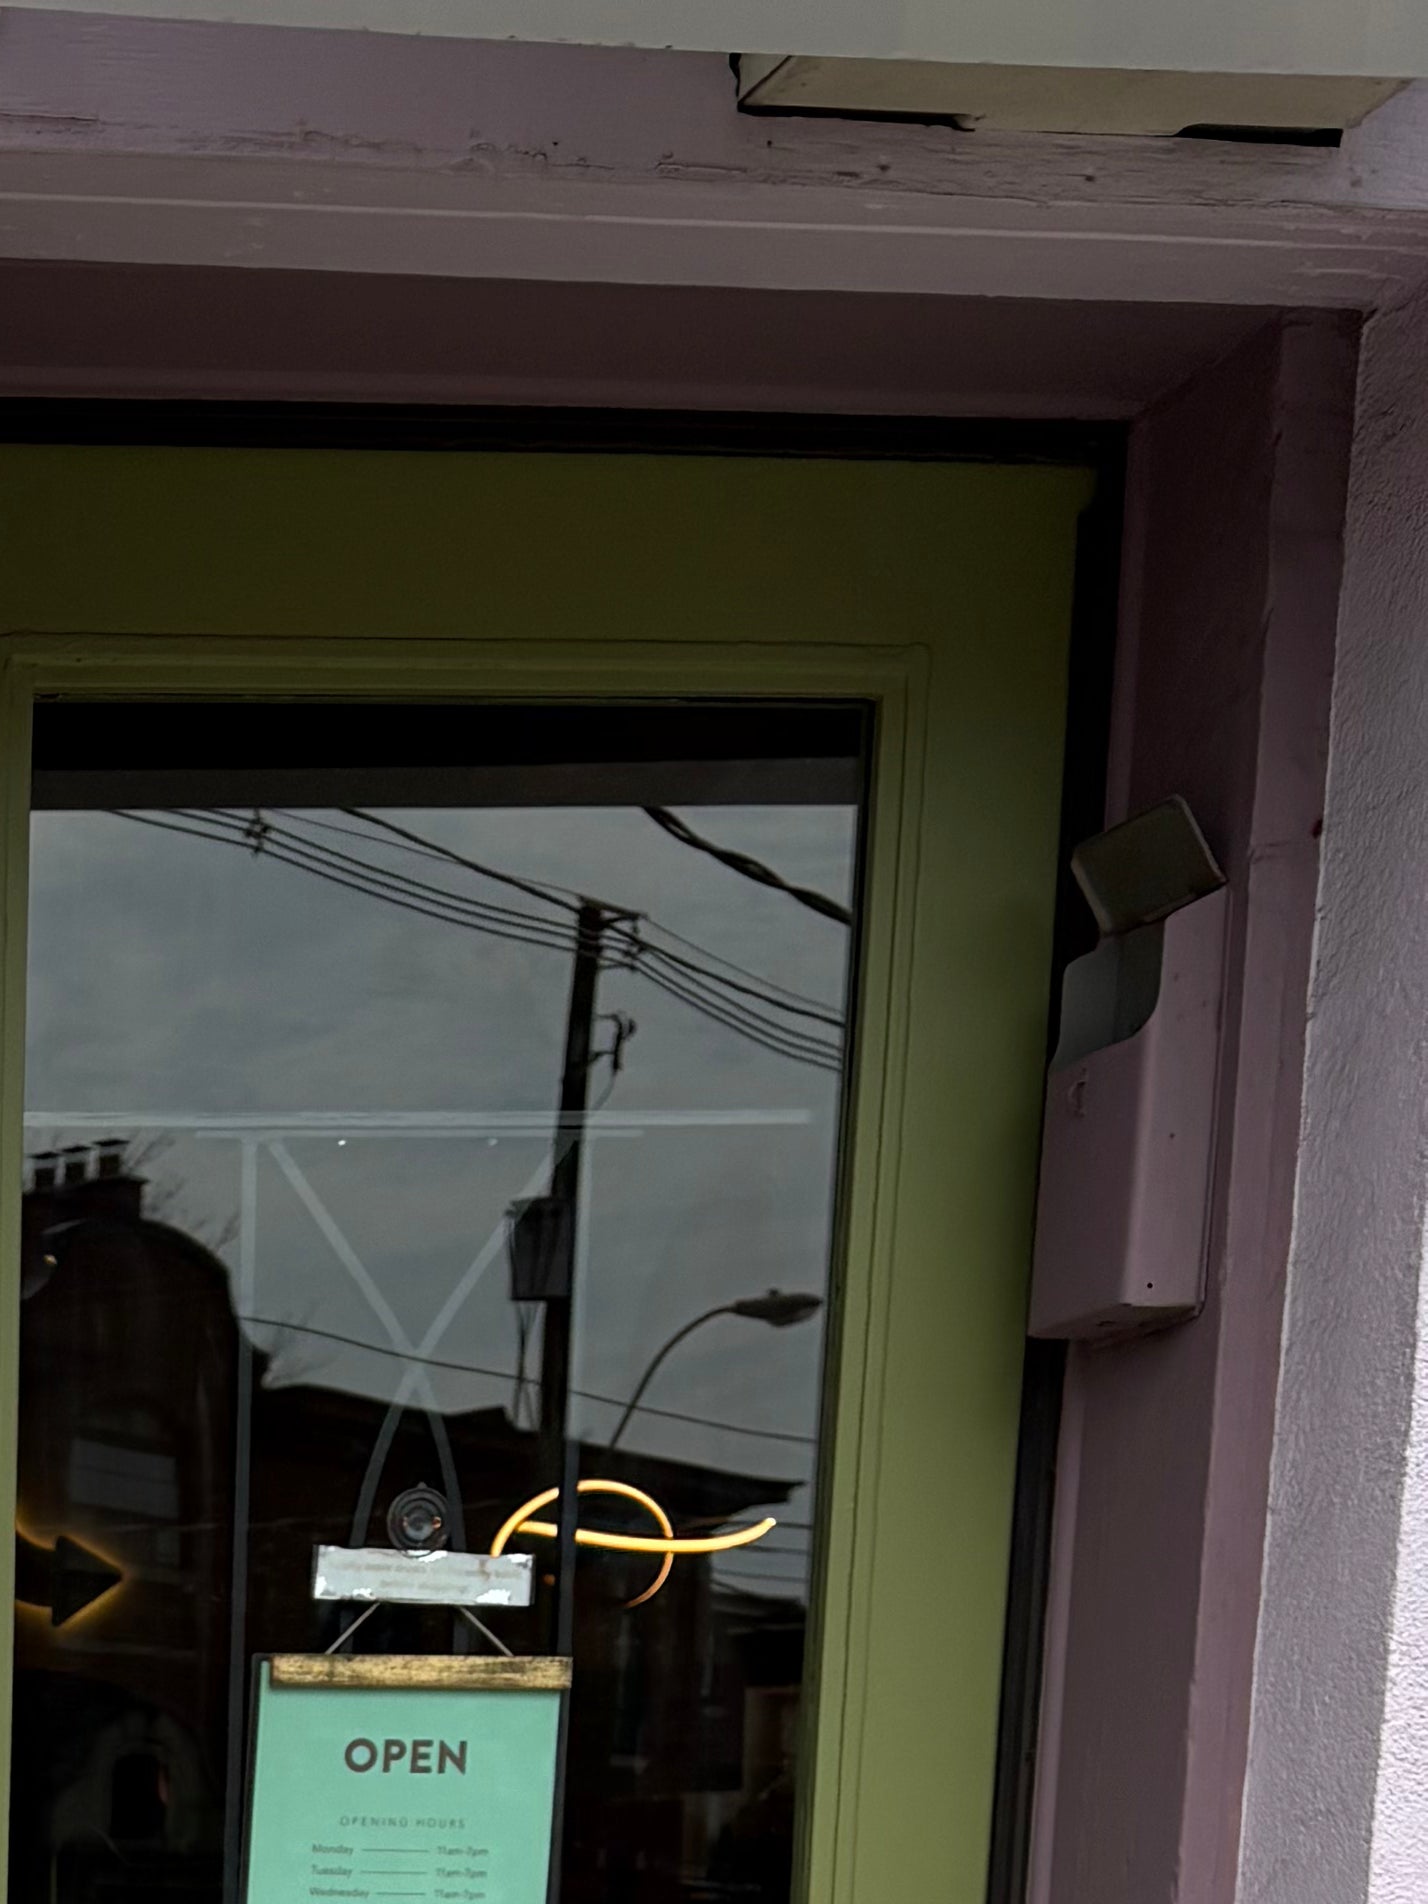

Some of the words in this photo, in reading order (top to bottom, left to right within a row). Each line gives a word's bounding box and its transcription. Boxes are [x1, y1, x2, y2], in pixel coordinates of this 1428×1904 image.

[344, 1738, 468, 1775] OPEN
[339, 1815, 409, 1829] OPENING
[415, 1817, 467, 1830] HOURS
[311, 1843, 354, 1857] Monday
[311, 1864, 353, 1879] Tuesday
[309, 1886, 370, 1899] Wednesday
